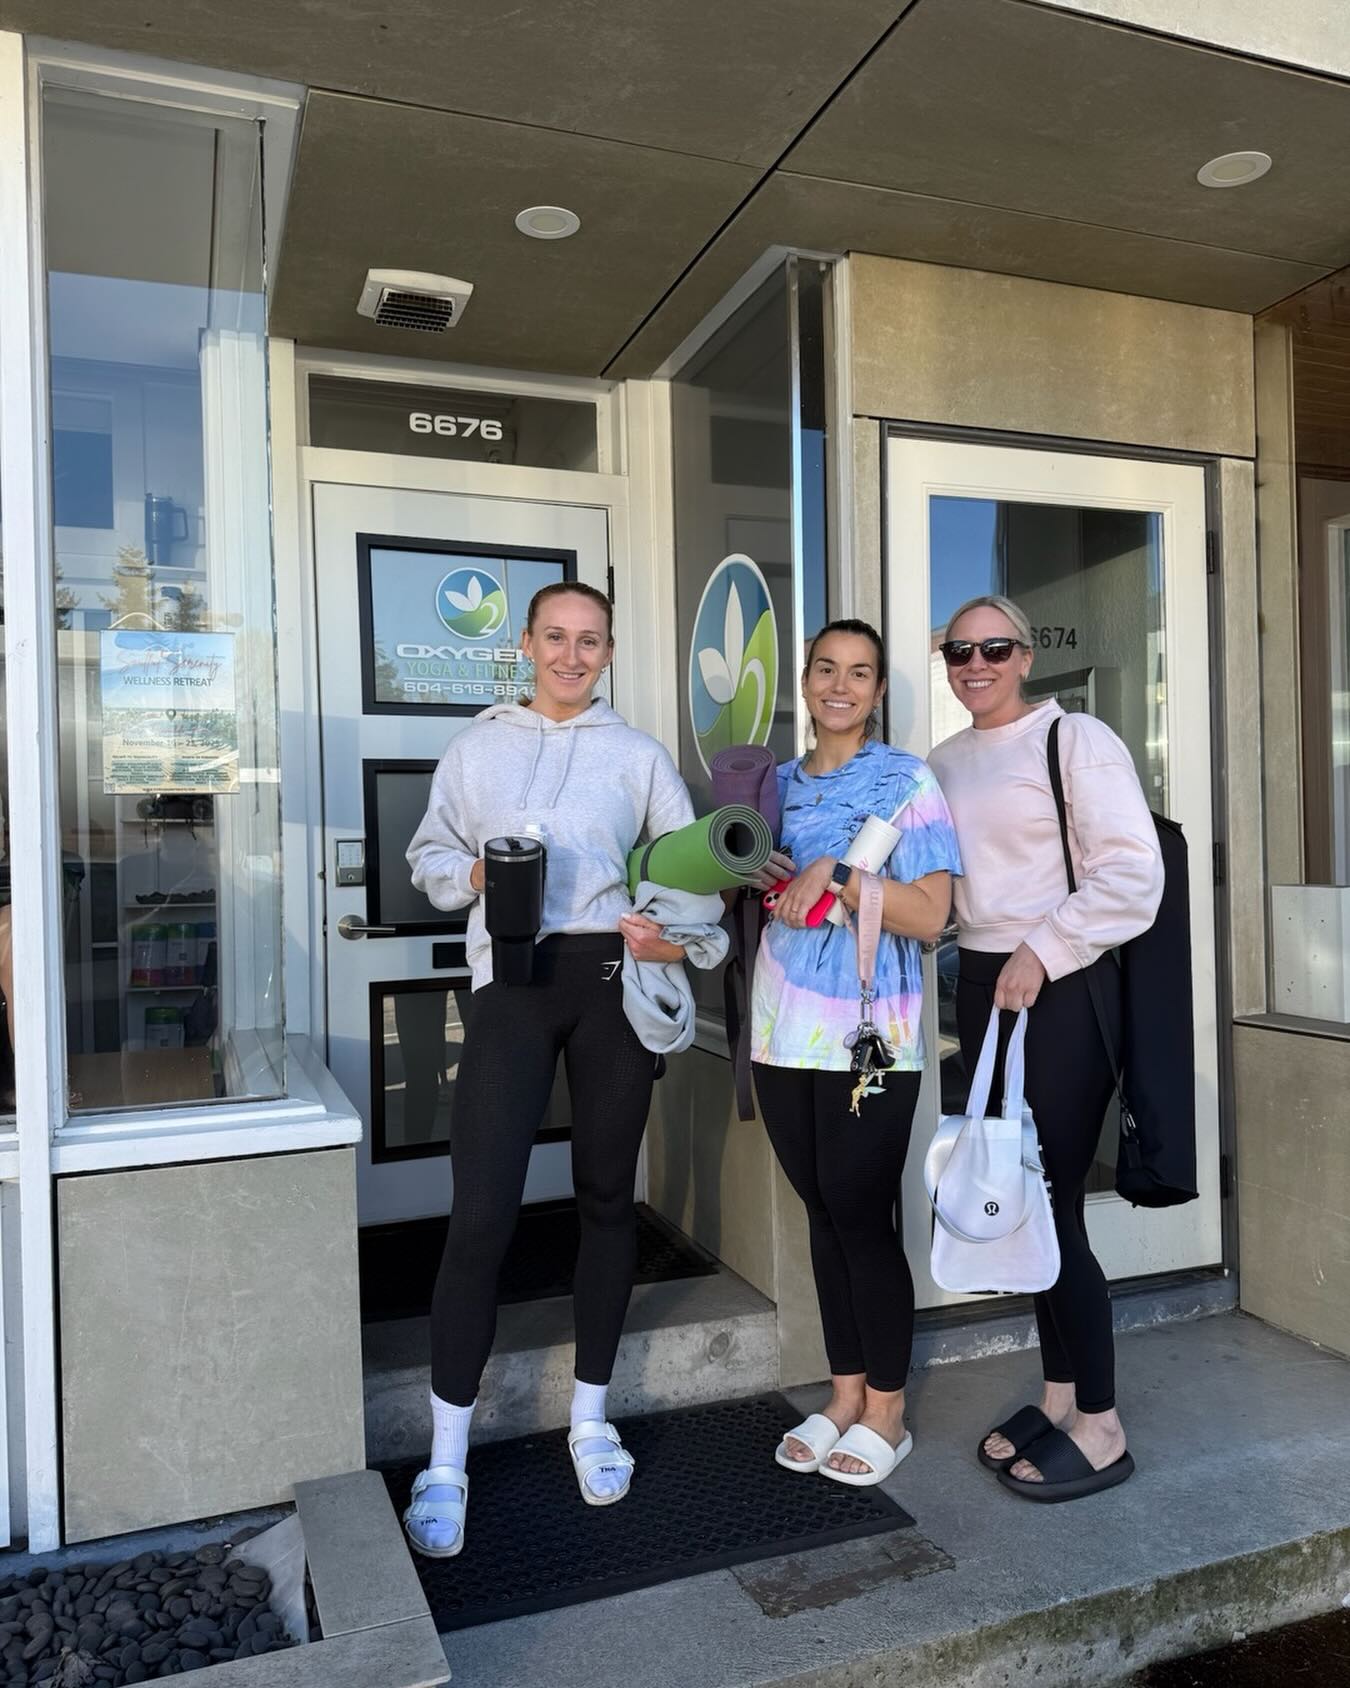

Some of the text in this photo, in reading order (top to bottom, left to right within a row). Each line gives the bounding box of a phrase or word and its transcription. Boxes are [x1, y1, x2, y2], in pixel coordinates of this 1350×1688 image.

[409, 412, 503, 441] 6676
[406, 661, 451, 677] YOGA
[457, 664, 469, 677] &
[122, 676, 213, 688] WELLNESS RETREAT
[122, 738, 165, 748] November
